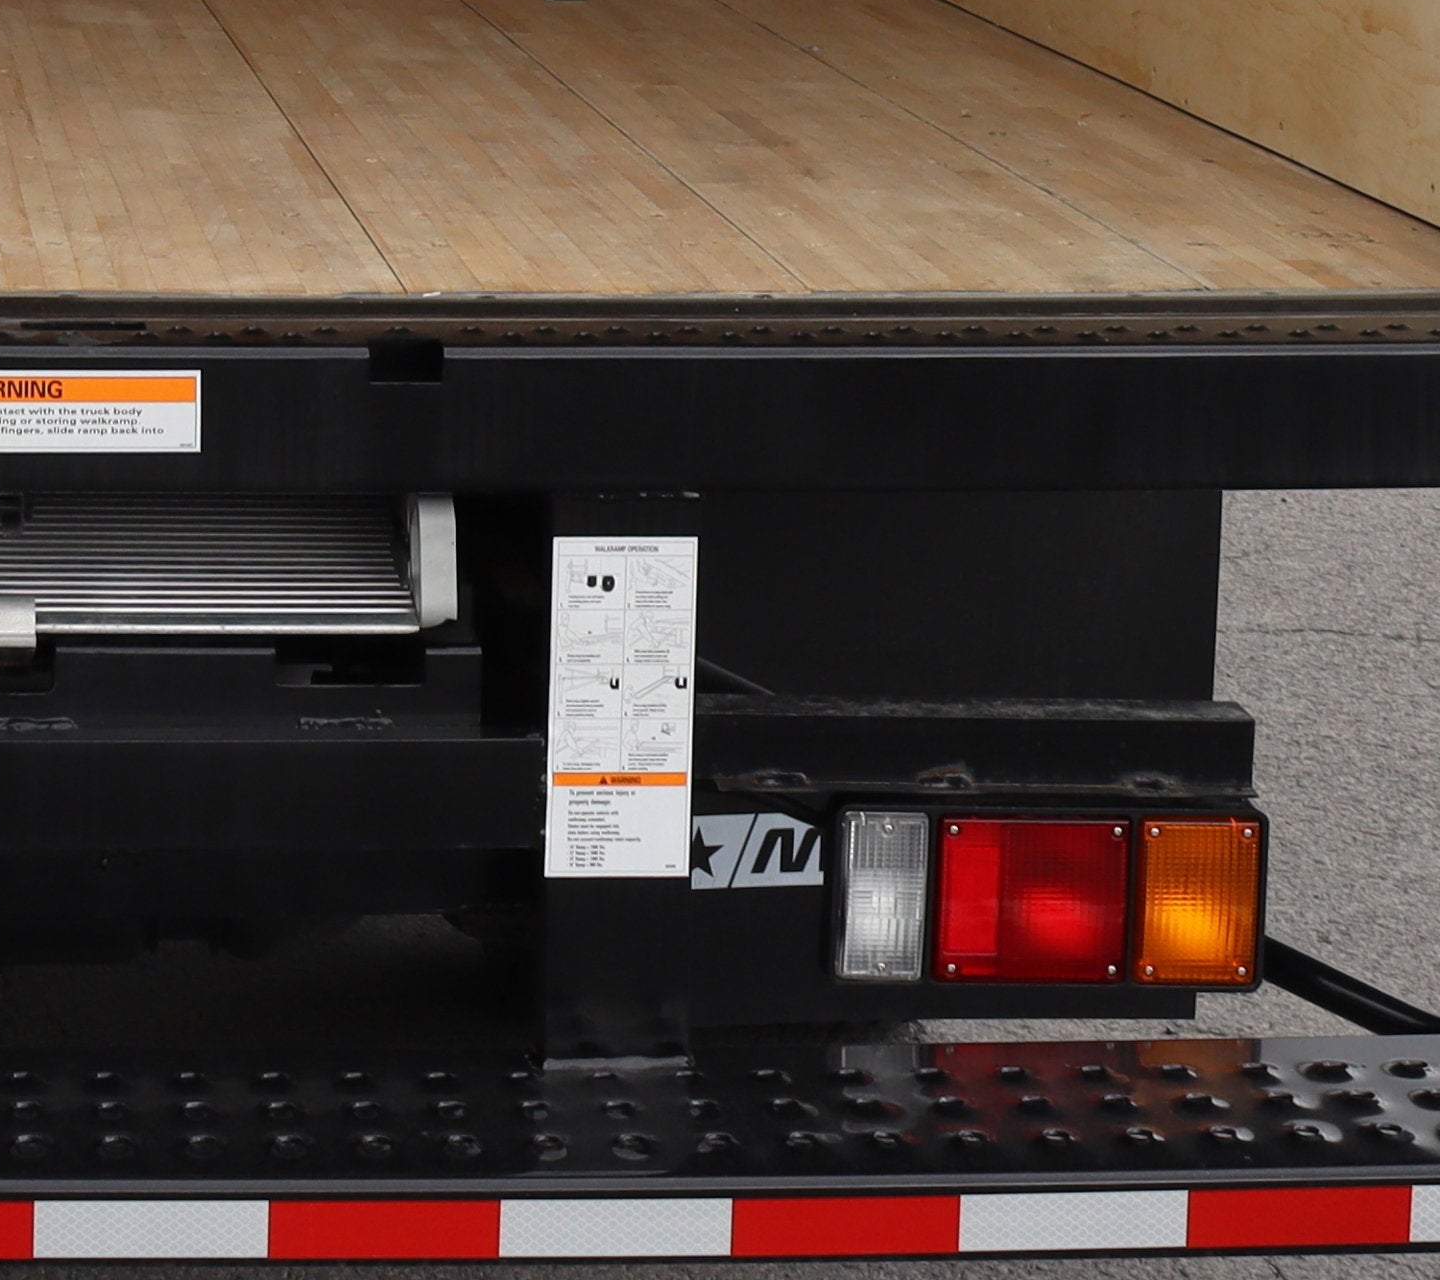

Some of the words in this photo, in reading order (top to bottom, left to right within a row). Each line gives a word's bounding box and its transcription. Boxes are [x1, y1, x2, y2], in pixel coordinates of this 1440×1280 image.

[29, 407, 55, 415] with
[58, 407, 77, 415] the
[80, 407, 110, 415] truck
[113, 407, 143, 417] body
[36, 417, 77, 426] storing
[1, 426, 44, 436] fingers,
[47, 426, 74, 435] slide
[77, 428, 108, 436] ramp
[111, 426, 138, 435] back
[141, 427, 164, 435] into
[610, 776, 642, 784] WARNING
